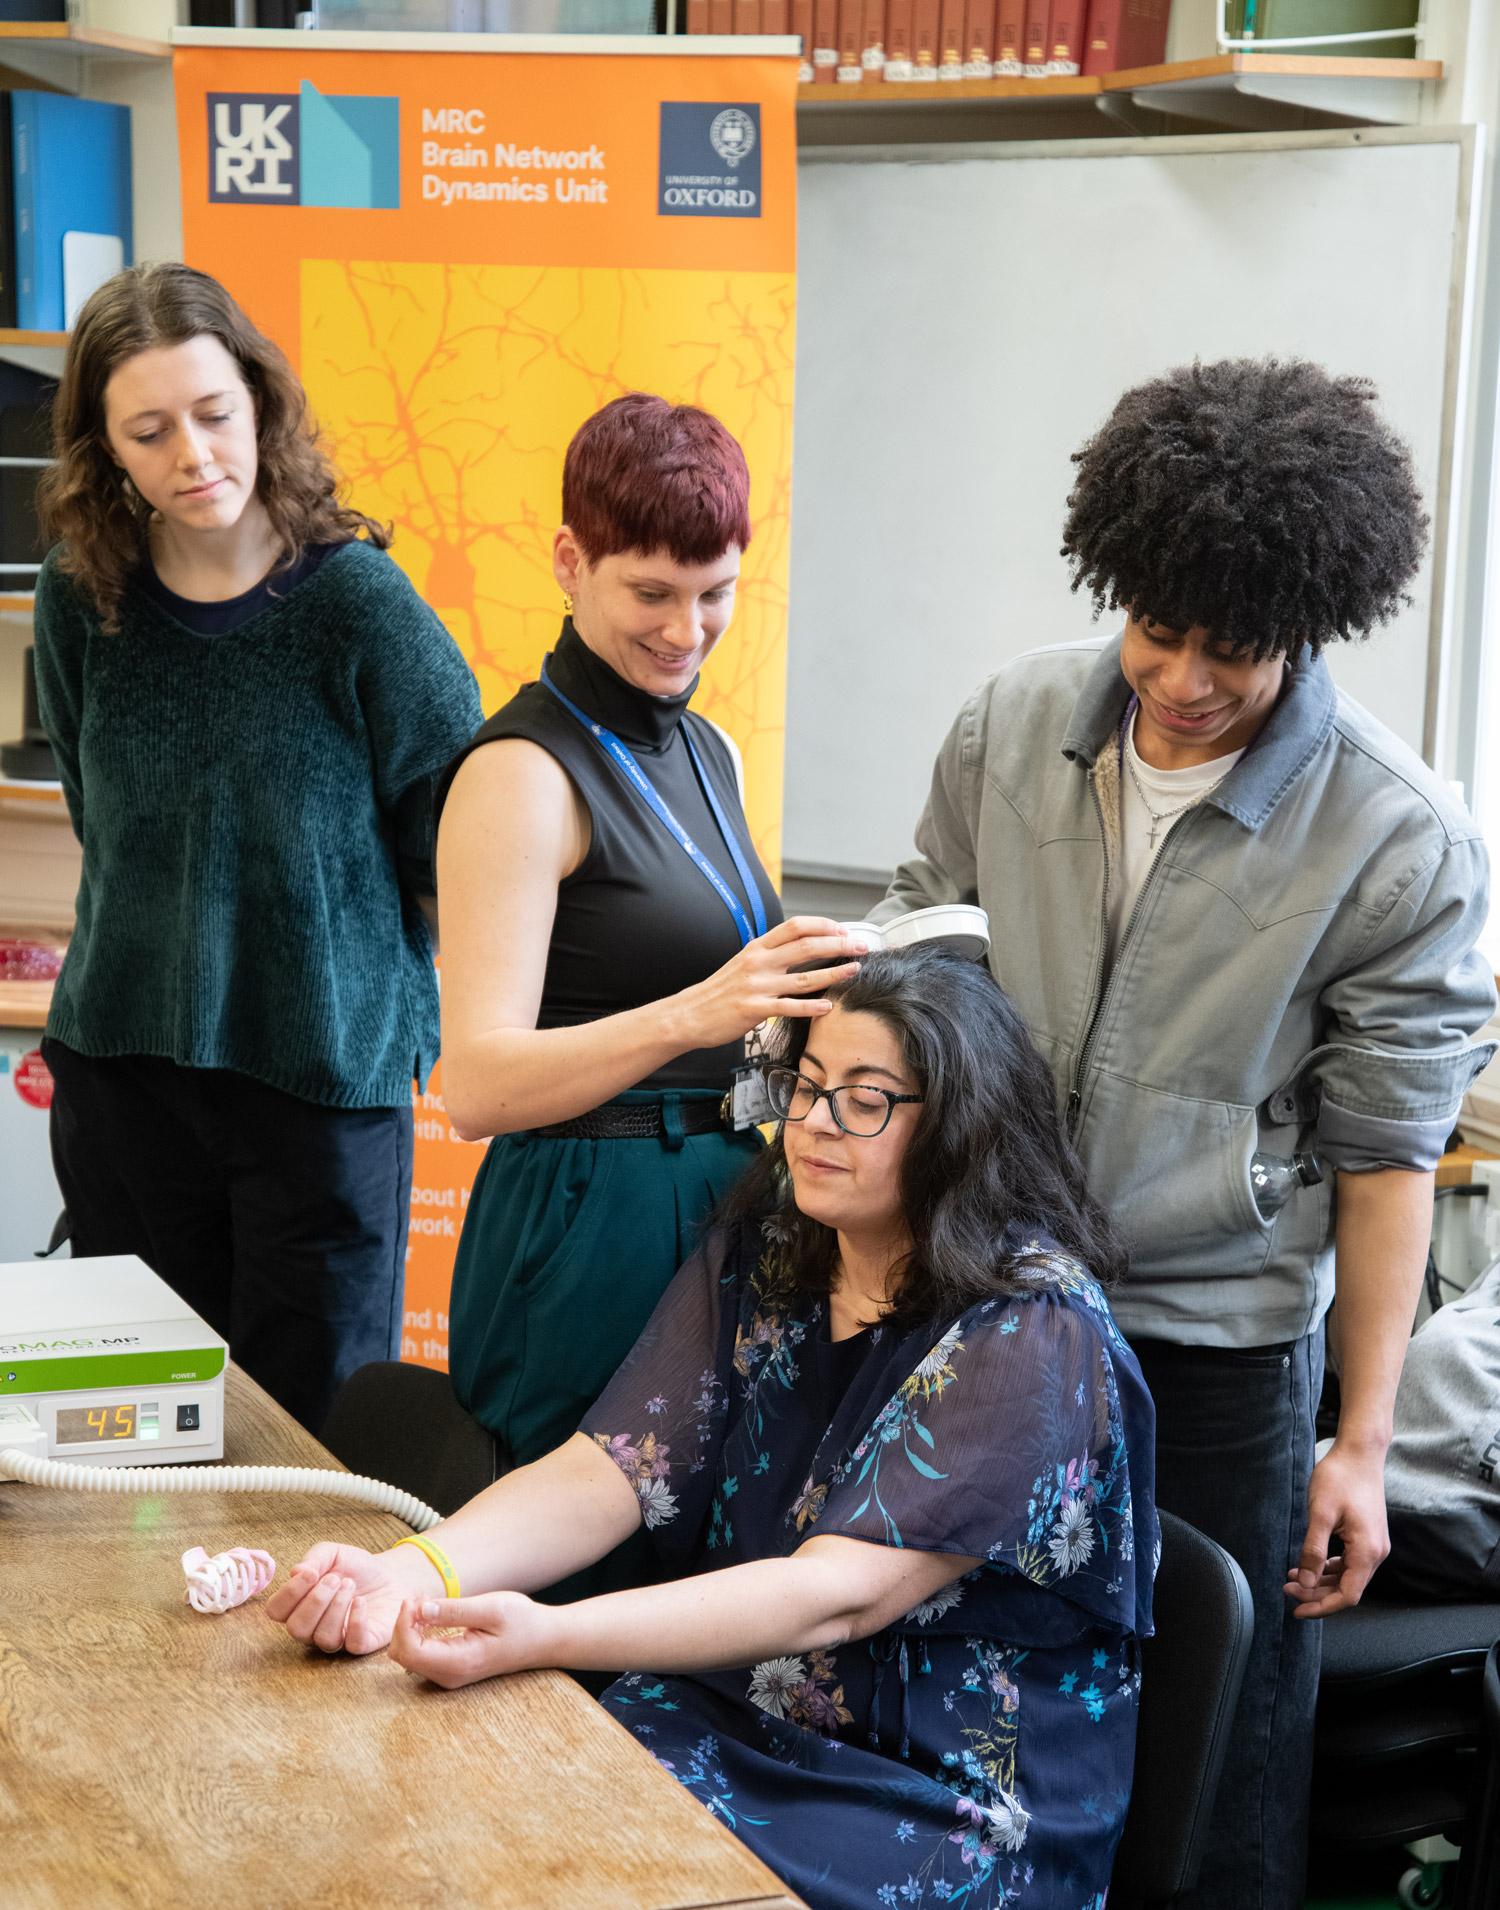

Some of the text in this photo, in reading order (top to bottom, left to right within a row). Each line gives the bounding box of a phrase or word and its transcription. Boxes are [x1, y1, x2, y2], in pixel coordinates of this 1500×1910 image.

[421, 108, 486, 134] MRC
[421, 141, 606, 171] Brain Network
[421, 175, 609, 207] Dynamics Unit
[664, 175, 739, 186] UNIVERSITY OF
[663, 187, 757, 208] OXFORD
[629, 764, 649, 791] University
[412, 1117, 446, 1142] ith
[411, 1186, 456, 1209] bout
[403, 1307, 432, 1331] nd
[100, 1335, 140, 1345] MP
[171, 1372, 197, 1380] POWER
[87, 1405, 134, 1438] 45
[1478, 1429, 1500, 1484] UR
